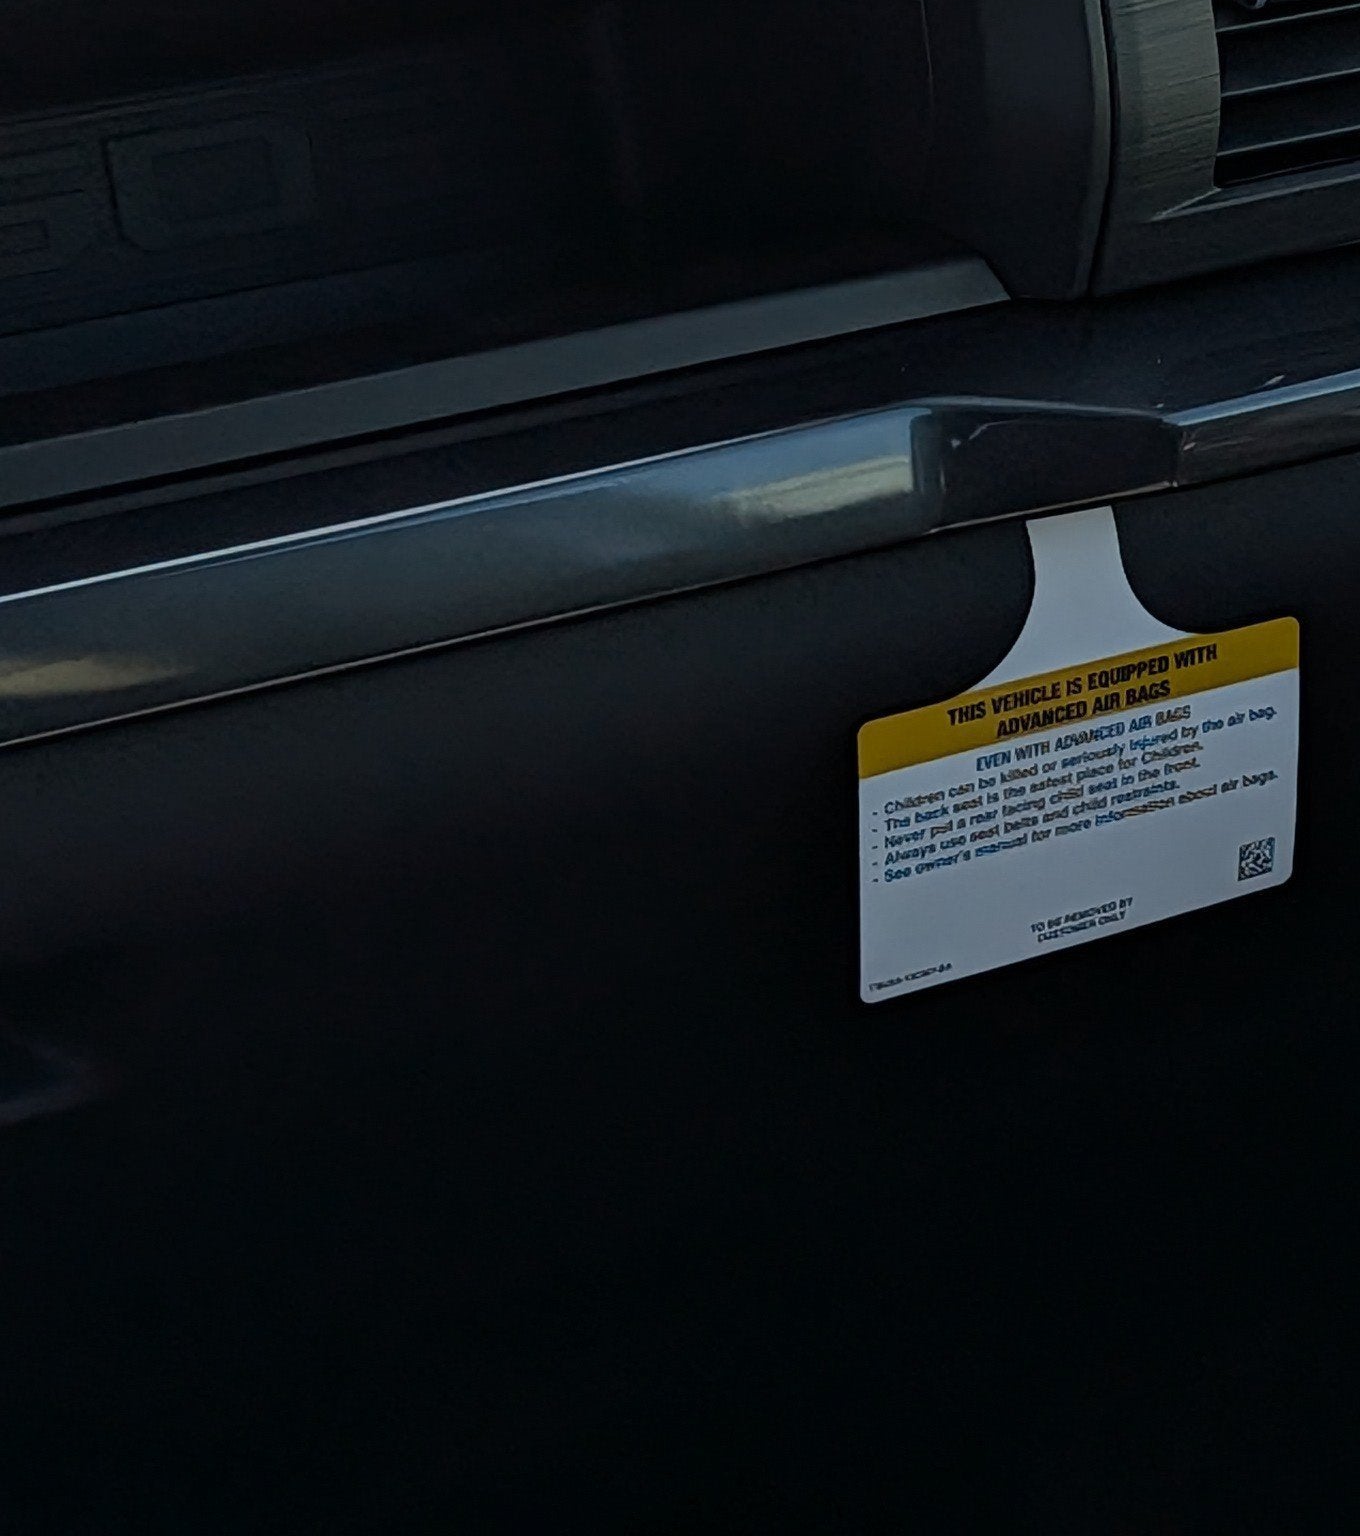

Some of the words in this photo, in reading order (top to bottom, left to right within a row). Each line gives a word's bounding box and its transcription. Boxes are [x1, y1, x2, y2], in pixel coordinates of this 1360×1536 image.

[947, 701, 987, 726] THIS
[991, 681, 1061, 715] VEHICLE
[1066, 677, 1082, 696] IS
[1088, 655, 1169, 691] EQUIPPED
[1173, 644, 1217, 669] WITH
[997, 700, 1088, 739] ADVANCED
[1092, 691, 1120, 715] AIR
[1126, 679, 1170, 706] BAGS
[884, 790, 945, 815] Children
[949, 783, 975, 798] can
[978, 776, 996, 790] be
[1000, 764, 1039, 784] killed
[1042, 761, 1057, 774] or
[1181, 725, 1199, 740] by
[1202, 718, 1225, 734] the
[1227, 712, 1245, 727] air
[1249, 706, 1277, 722] bag.
[976, 749, 1011, 772] EVEN
[1014, 740, 1050, 762] WITH
[1055, 721, 1125, 752] ADVANCED
[1129, 715, 1152, 733] AIR
[1155, 704, 1191, 725] BAGS
[884, 866, 911, 883] See
[1031, 828, 1051, 843] for
[1055, 819, 1091, 837] more
[1221, 779, 1239, 793] air
[1242, 770, 1279, 786] bags.
[885, 816, 911, 832] The
[914, 805, 949, 824] back
[986, 792, 1000, 805] is
[1003, 785, 1026, 800] the
[1076, 764, 1115, 785] place
[1118, 757, 1138, 771] for
[885, 828, 926, 849] Never
[956, 817, 967, 830] a
[1138, 768, 1160, 782] the
[885, 843, 936, 866] Always
[940, 835, 967, 850] use
[1042, 805, 1070, 823] and
[1072, 796, 1107, 815] child
